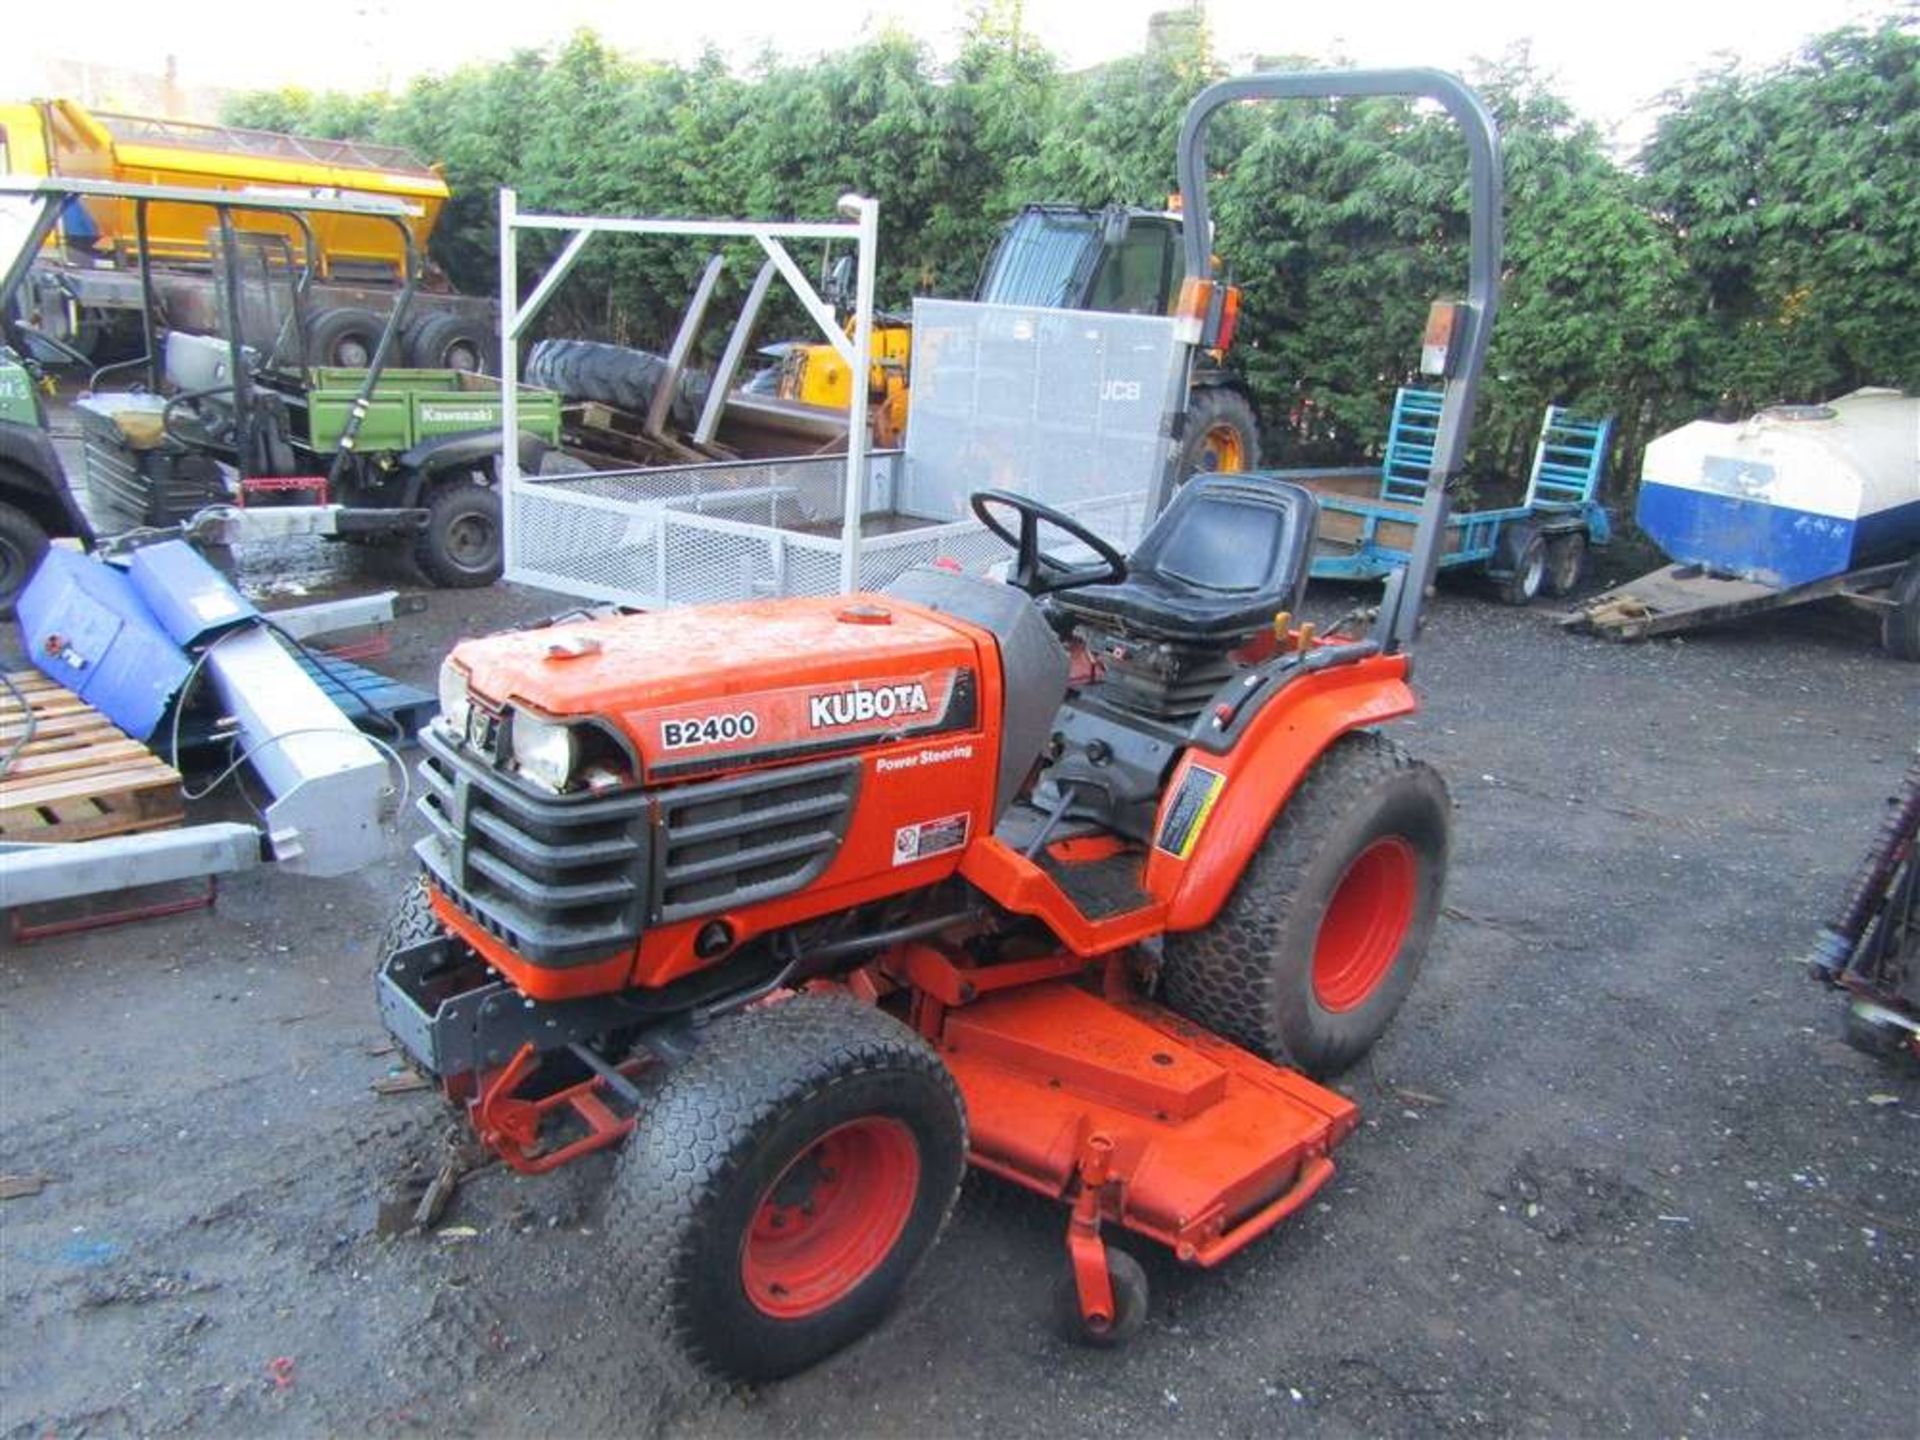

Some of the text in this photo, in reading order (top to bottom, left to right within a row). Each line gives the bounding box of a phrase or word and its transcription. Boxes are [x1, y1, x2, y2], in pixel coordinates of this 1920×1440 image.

[1101, 380, 1140, 401] JCB
[421, 407, 493, 422] Kawasaki
[810, 684, 929, 728] KUBOTA
[663, 712, 757, 747] B2400
[876, 746, 972, 773] Power Steering
